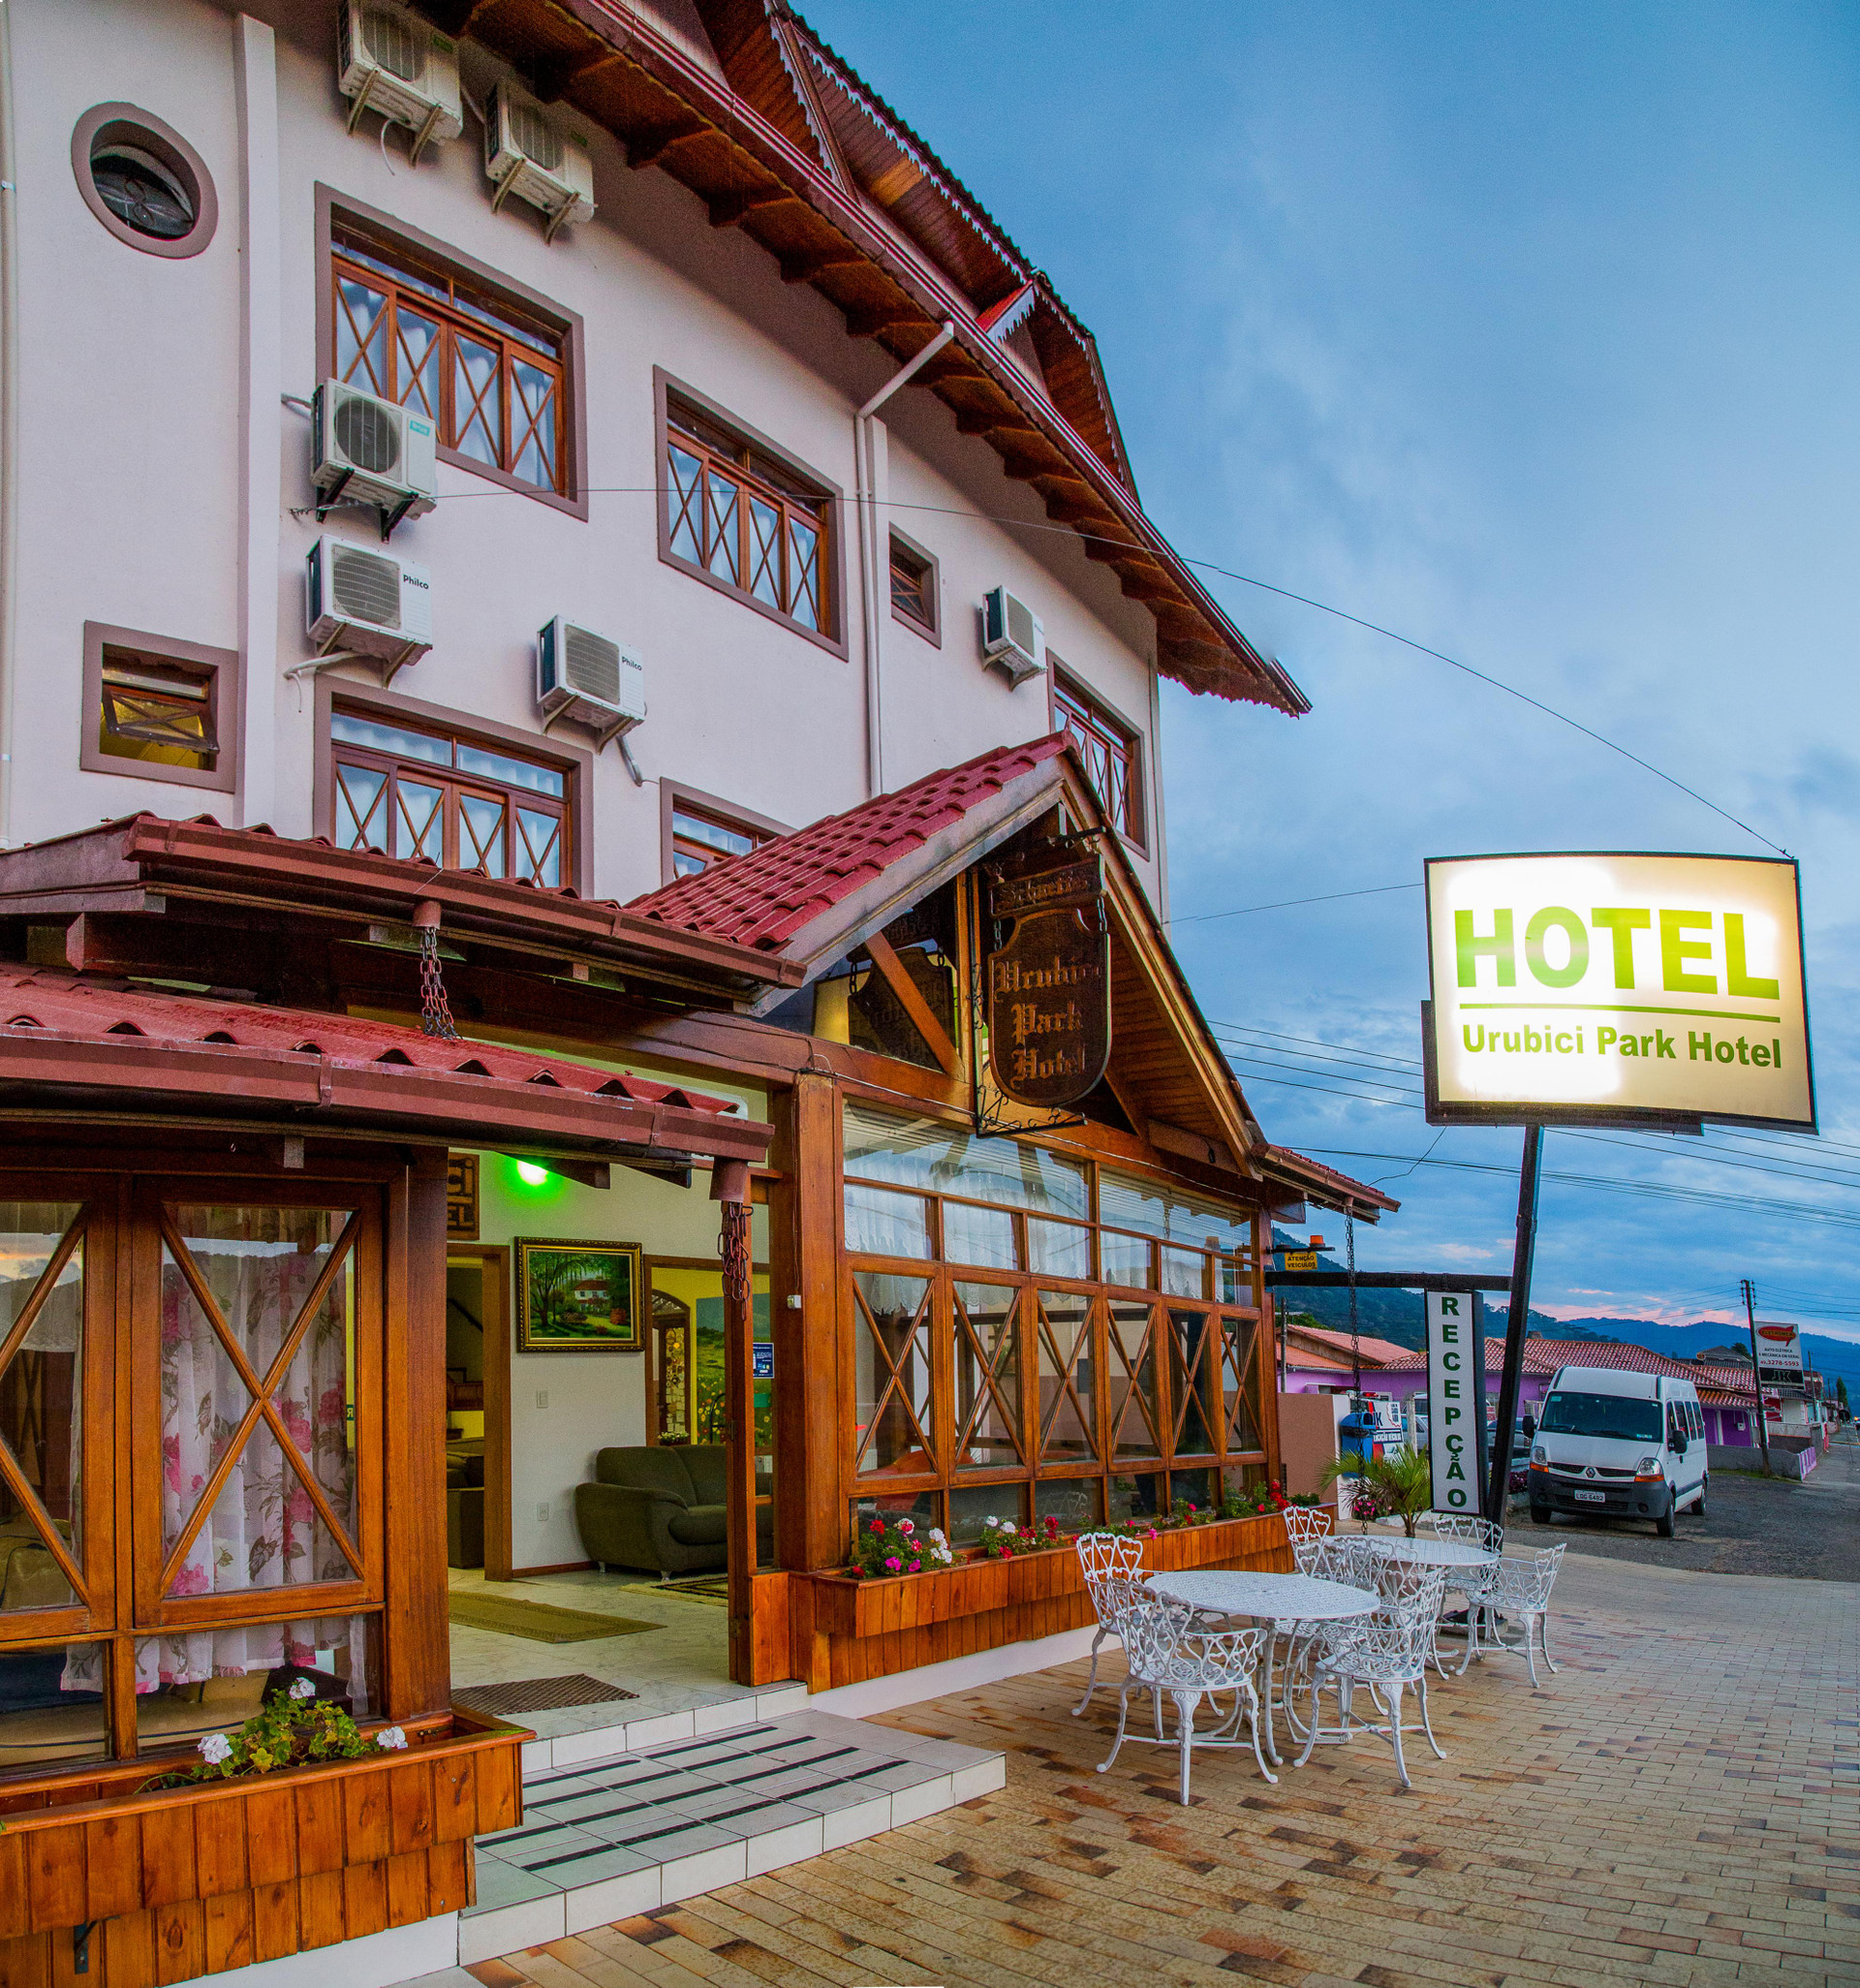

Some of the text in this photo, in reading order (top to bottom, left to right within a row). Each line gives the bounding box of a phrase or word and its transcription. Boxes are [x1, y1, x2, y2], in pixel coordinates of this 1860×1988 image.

[403, 574, 429, 590] Philco
[621, 656, 642, 671] Philco
[1454, 905, 1781, 1001] HOTEL
[1010, 1001, 1083, 1045] Park
[1009, 1044, 1087, 1091] Hotel
[1463, 1024, 1782, 1069] Urubici Park Hotel
[1441, 1296, 1468, 1508] RECEPÇÃO
